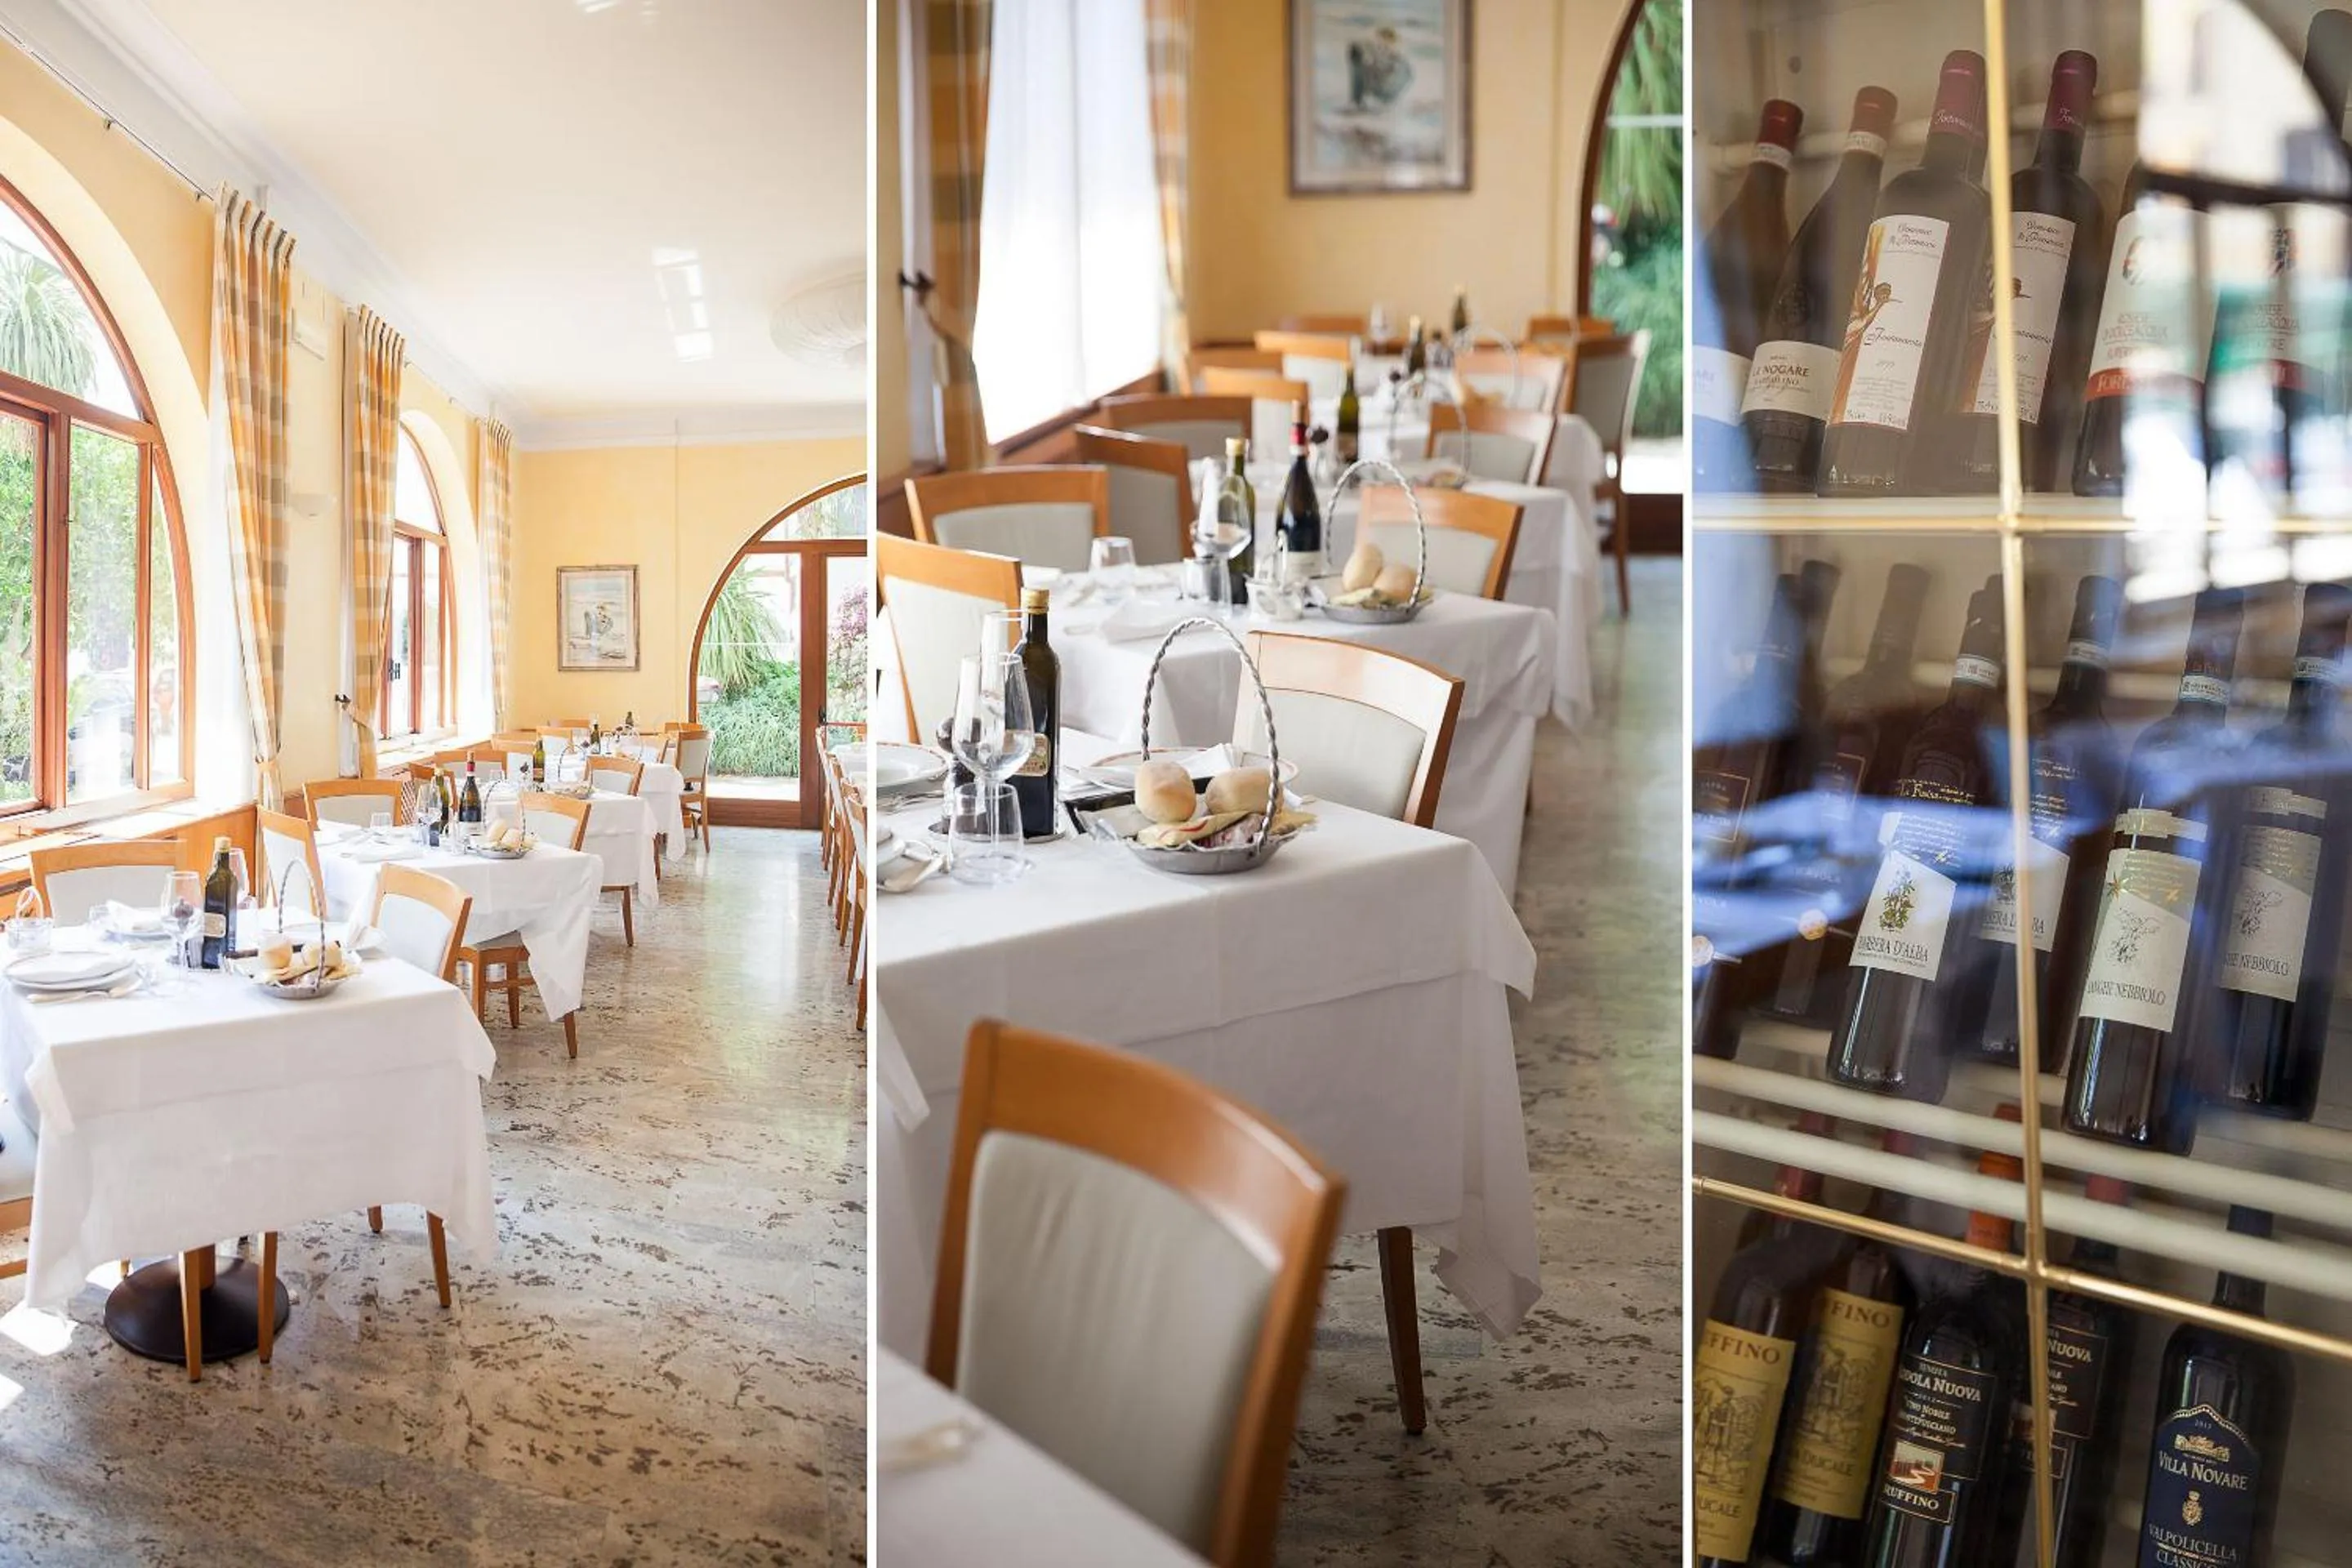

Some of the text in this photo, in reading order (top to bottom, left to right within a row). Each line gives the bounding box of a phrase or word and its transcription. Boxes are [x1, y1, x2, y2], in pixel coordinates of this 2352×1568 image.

[1932, 1377, 1982, 1403] NUOVA
[2158, 1450, 2189, 1478] VILLA
[2190, 1462, 2249, 1491] NOVARE
[1883, 1482, 1940, 1511] RUFFINO
[2148, 1522, 2238, 1561] VALPOLICELLA
[2156, 1549, 2218, 1568] CLASSIC
